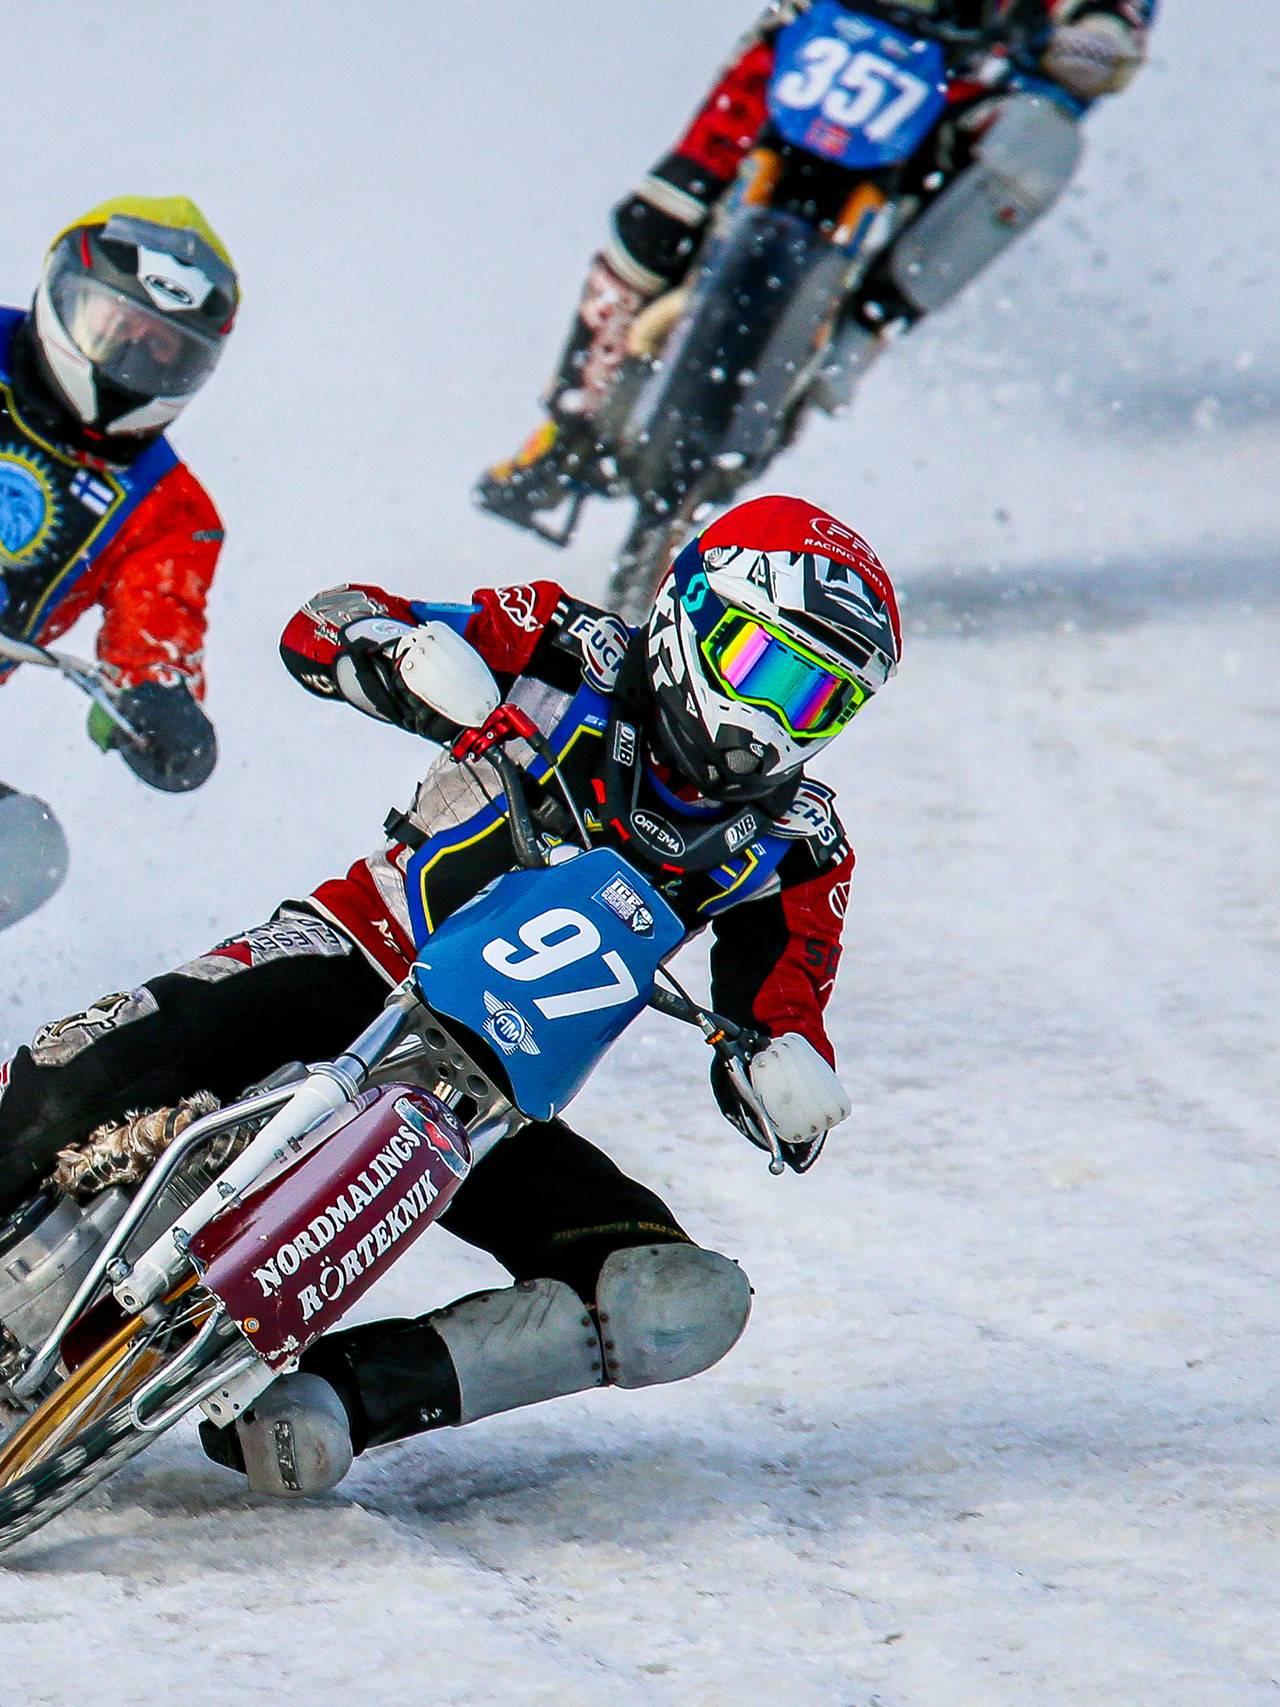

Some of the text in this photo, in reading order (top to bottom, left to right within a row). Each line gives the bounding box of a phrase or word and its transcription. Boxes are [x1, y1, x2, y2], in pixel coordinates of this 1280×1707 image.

[774, 37, 929, 142] 357
[804, 538, 855, 562] RACING
[573, 619, 624, 673] FUC
[787, 800, 835, 842] CHS
[609, 878, 645, 911] ICE
[249, 928, 340, 953] FLIESEN
[482, 908, 639, 1020] 97
[496, 1015, 520, 1041] FIM
[252, 1125, 421, 1297] NORDMALINGS
[297, 1168, 440, 1320] RÖRTEKNIK
